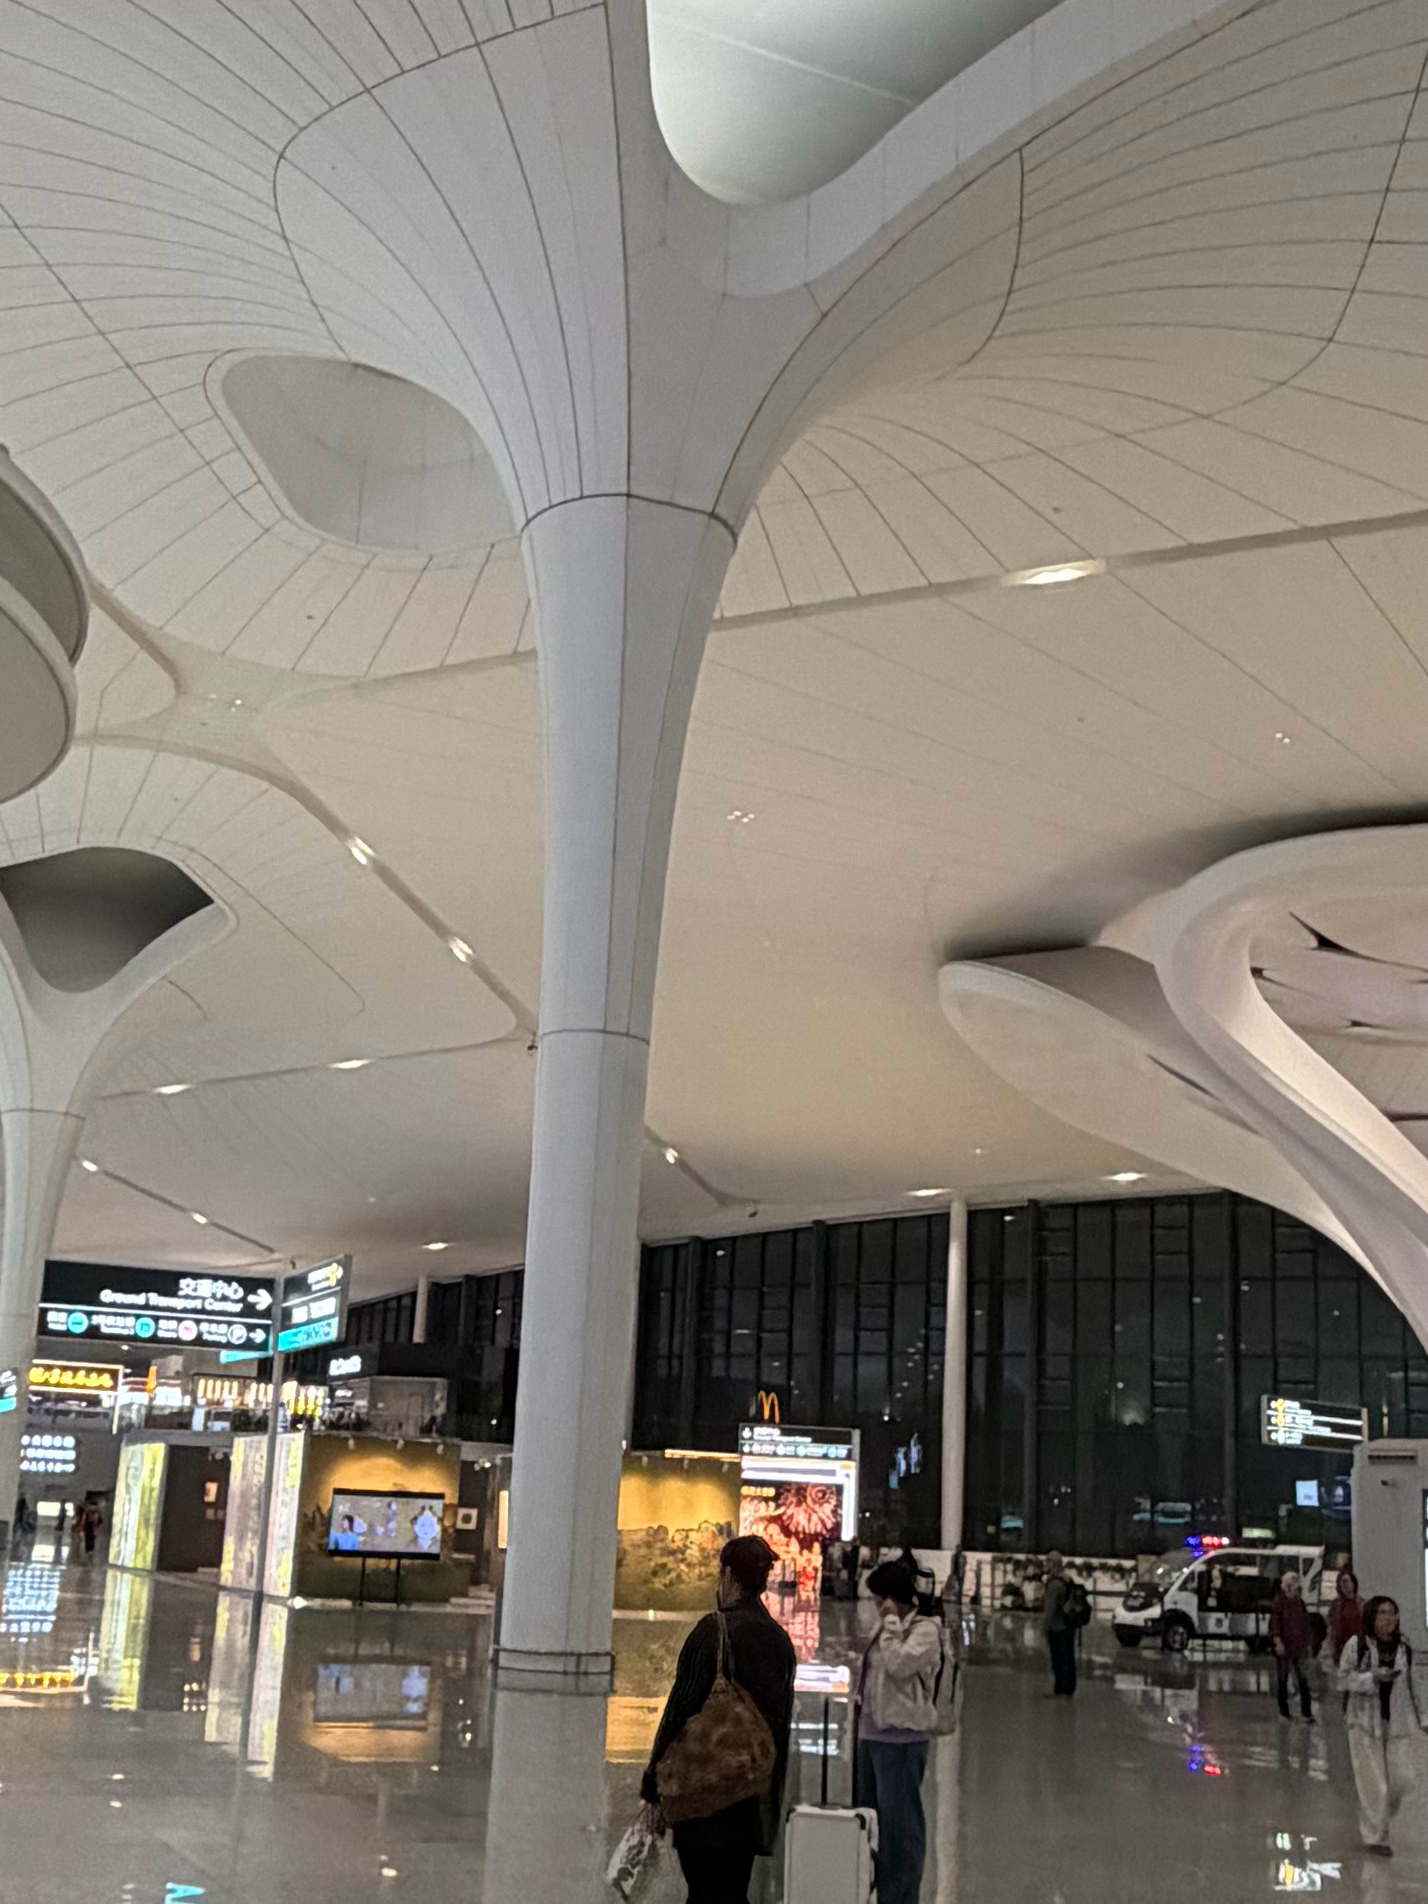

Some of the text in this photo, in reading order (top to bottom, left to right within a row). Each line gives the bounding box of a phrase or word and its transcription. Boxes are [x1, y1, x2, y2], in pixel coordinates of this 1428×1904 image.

[179, 1278, 244, 1299] 交通中心
[100, 1289, 244, 1313] Ground Transport Center
